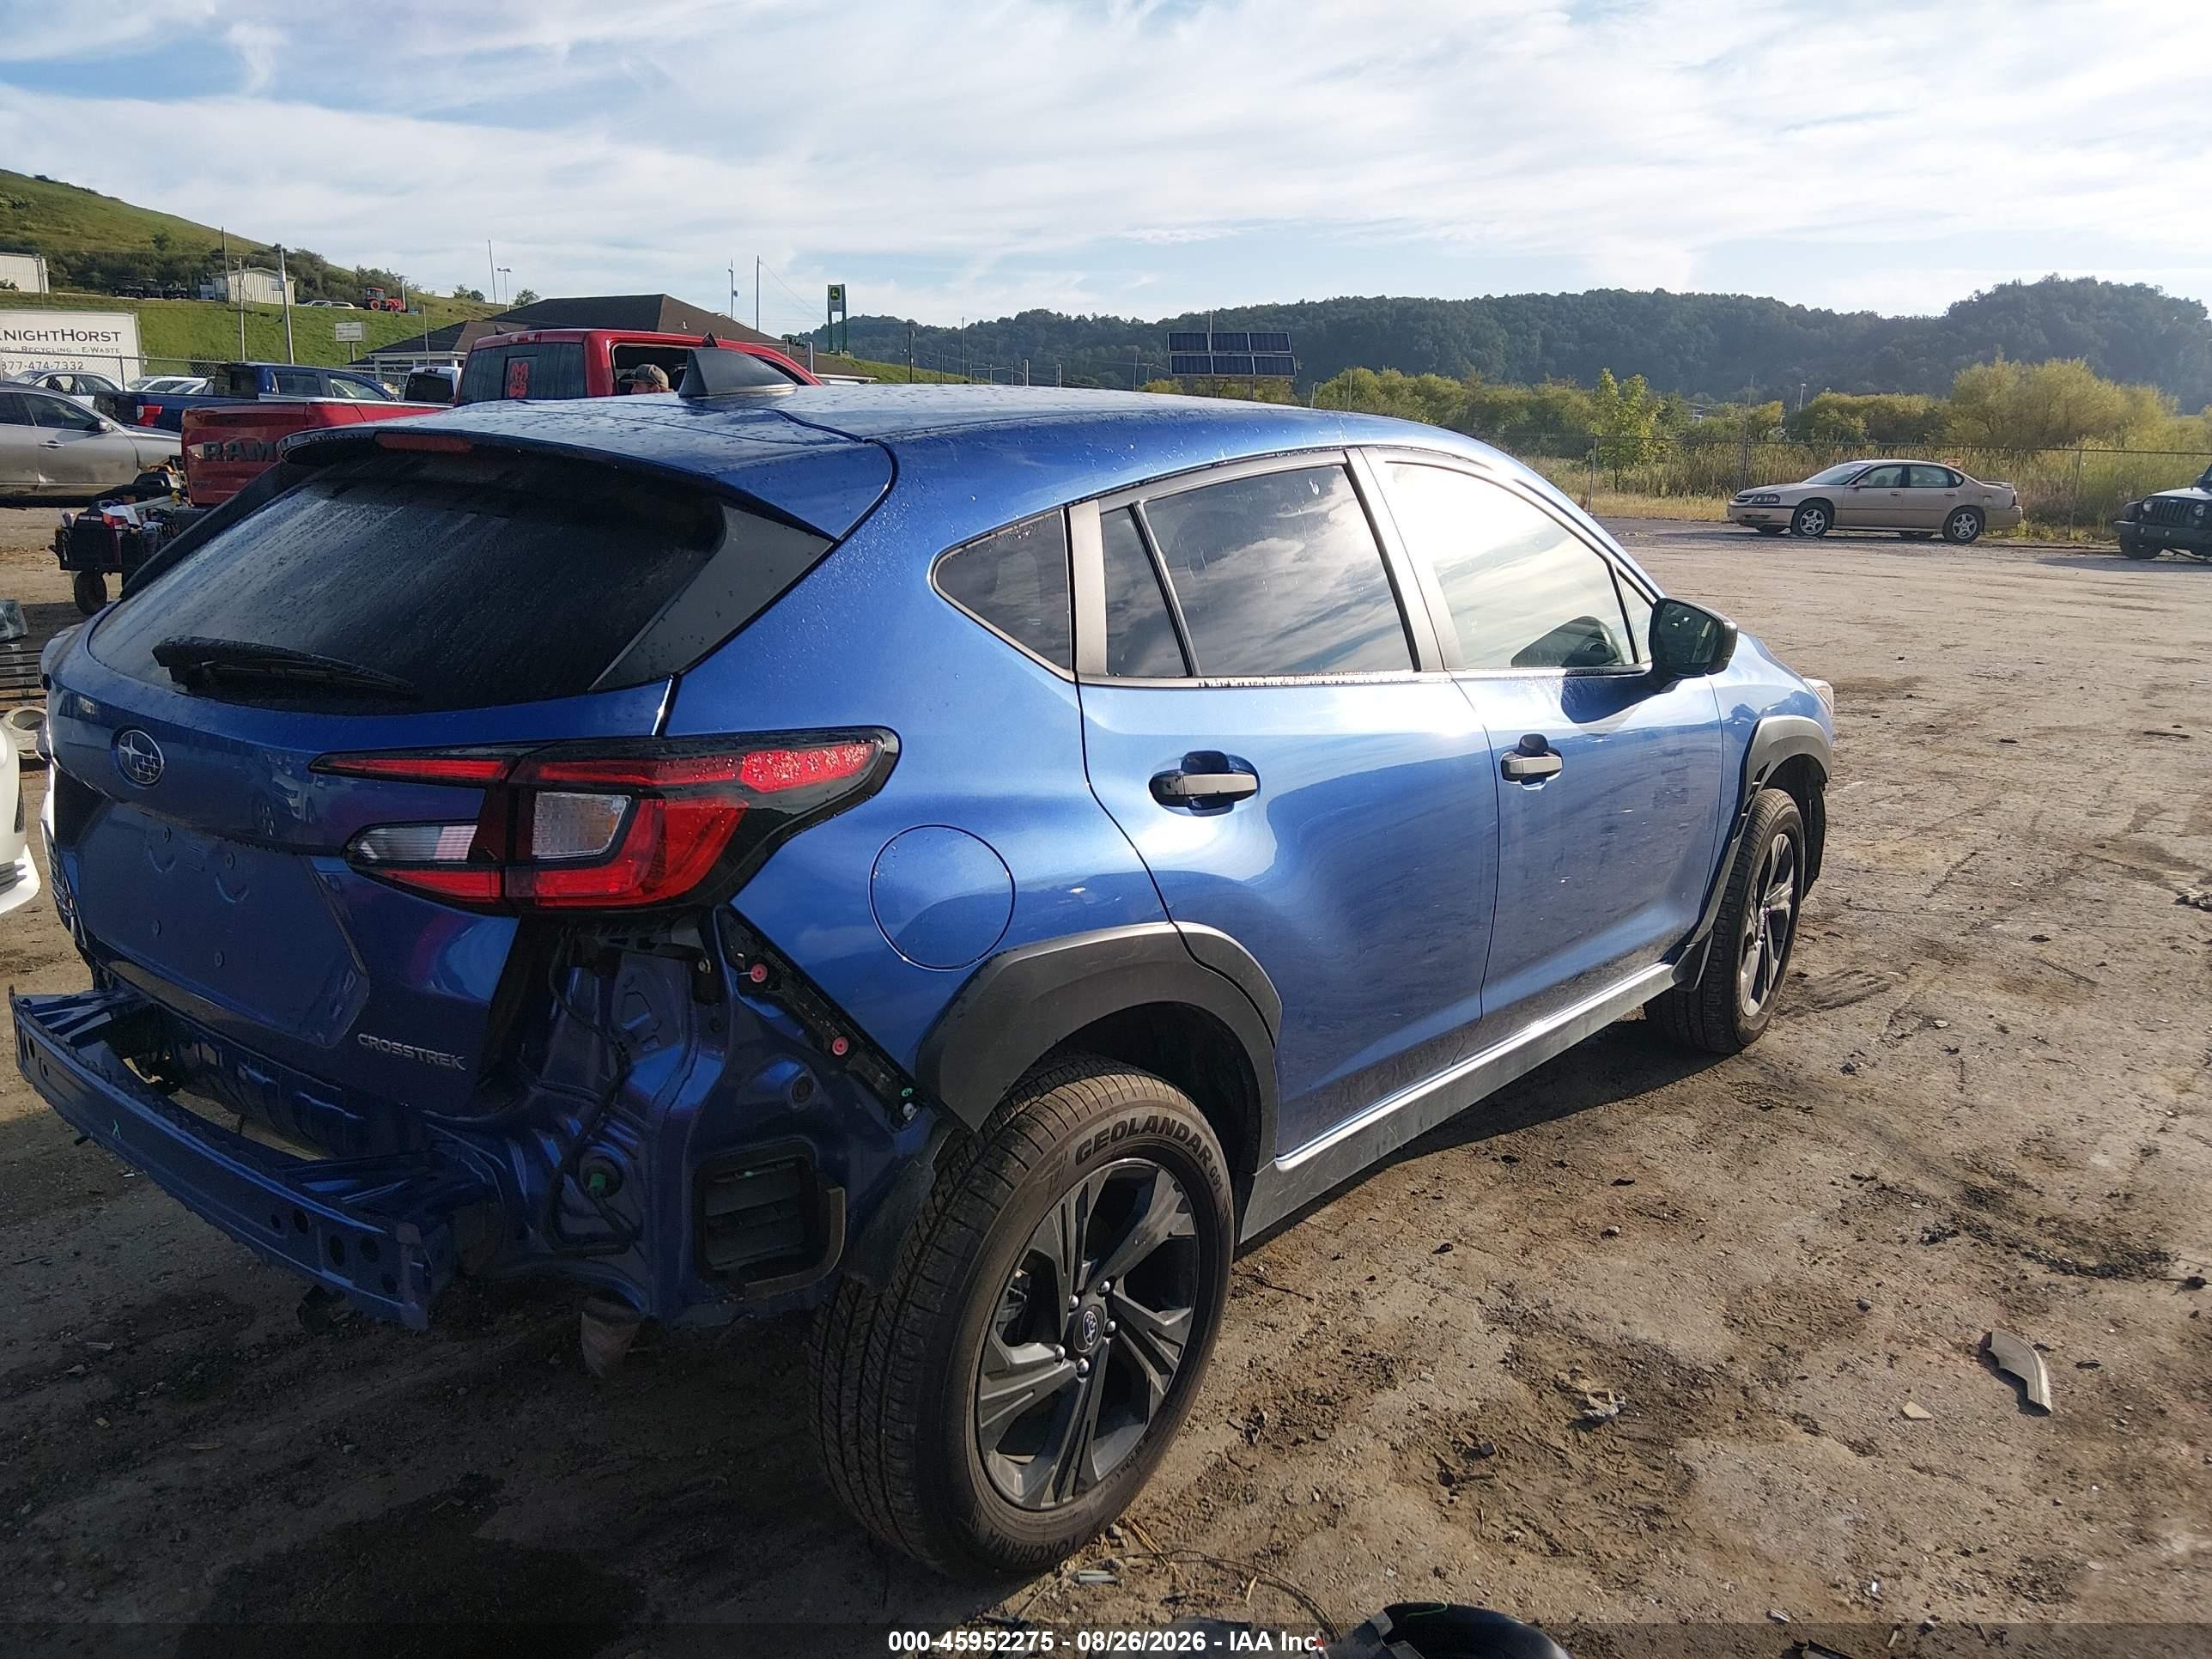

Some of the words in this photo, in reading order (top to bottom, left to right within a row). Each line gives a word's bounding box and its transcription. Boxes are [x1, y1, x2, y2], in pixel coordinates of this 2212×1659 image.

[0, 329, 121, 342] NIGHTHORST
[203, 439, 276, 462] RAM
[358, 1033, 465, 1070] CROSSTREK
[1076, 1115, 1213, 1168] GEOLANDAR
